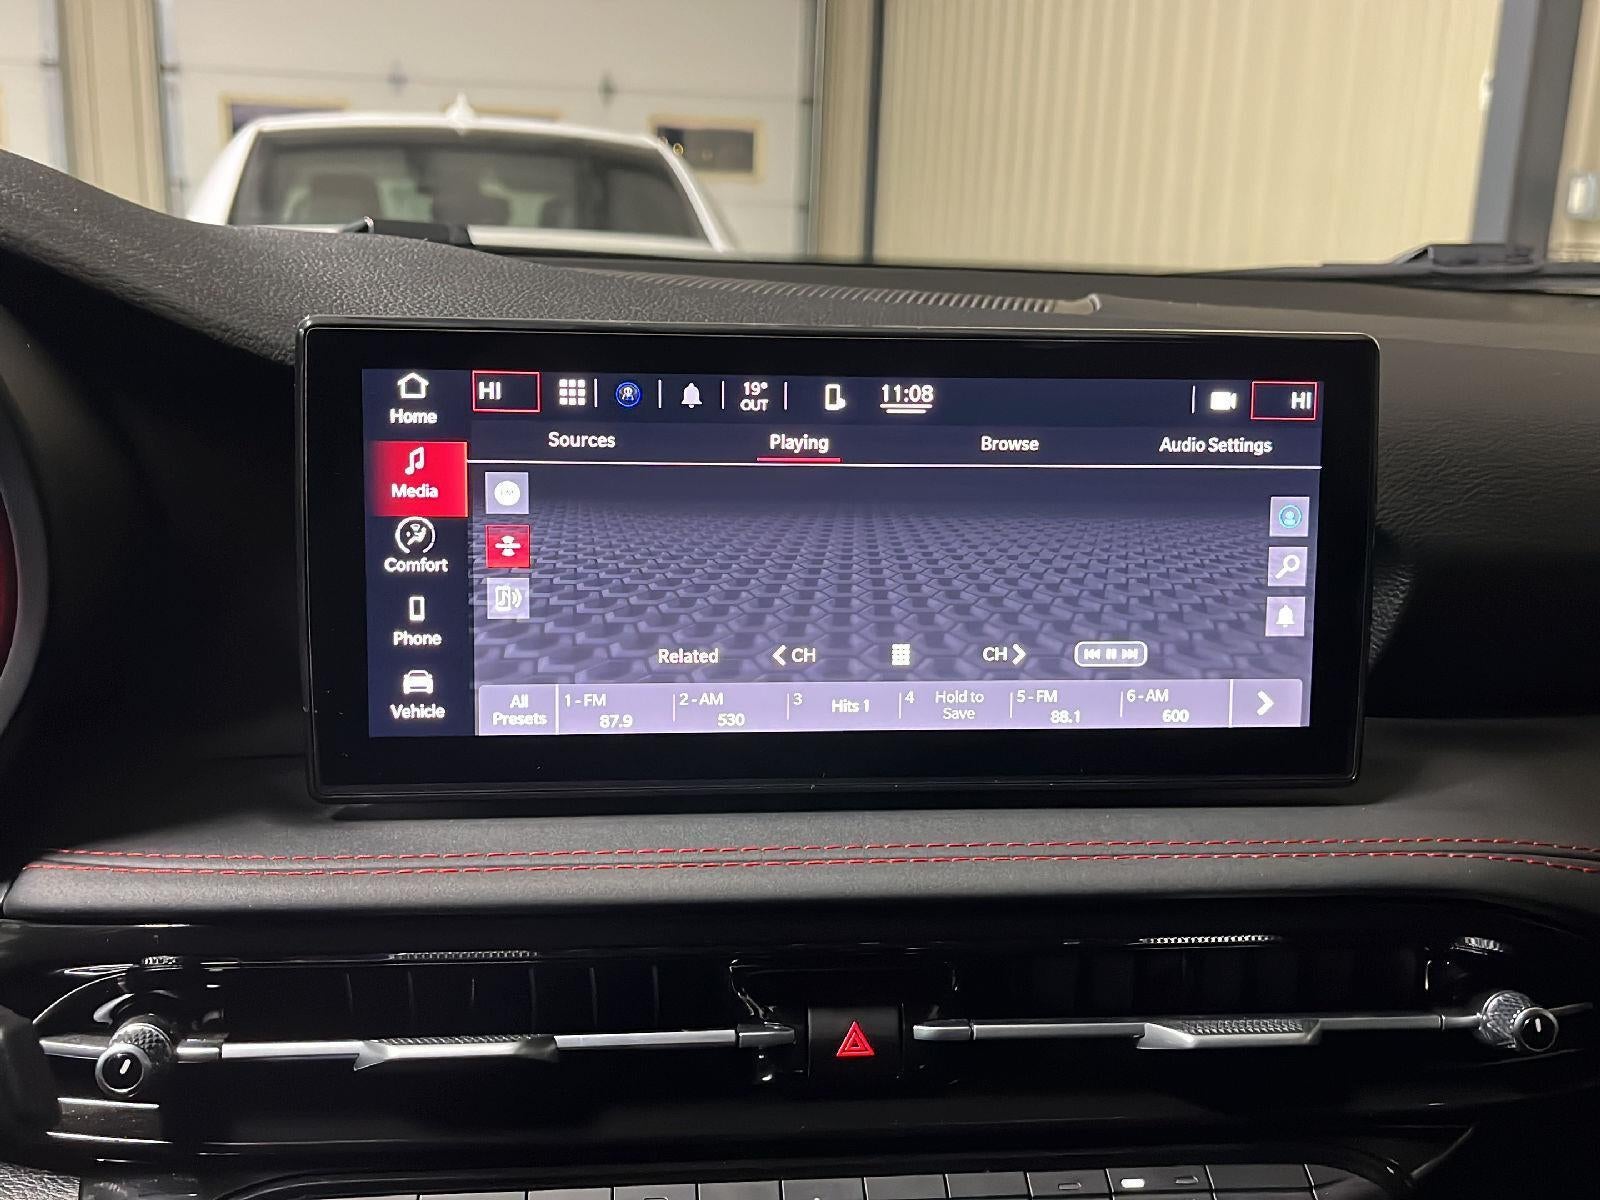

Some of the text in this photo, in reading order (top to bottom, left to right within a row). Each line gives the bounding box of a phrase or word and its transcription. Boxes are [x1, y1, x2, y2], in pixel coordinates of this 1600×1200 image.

[478, 381, 501, 400] HI
[743, 381, 768, 396] 19°
[881, 384, 934, 403] 11:08
[740, 399, 768, 412] OUT
[1290, 391, 1312, 410] HI
[390, 408, 437, 424] Home
[548, 431, 616, 449] Sources
[769, 433, 829, 454] Playing
[981, 435, 1039, 452] Browse
[1159, 437, 1273, 456] Audio Settings
[391, 483, 438, 498] Media
[384, 557, 448, 573] Comfort
[393, 631, 442, 646] Phone
[658, 648, 719, 664] Related
[791, 647, 816, 663] CH
[982, 646, 1008, 662] CH
[509, 694, 529, 708] All
[793, 693, 803, 706] 3
[904, 691, 915, 704] 4
[935, 690, 985, 704] Hold to
[390, 703, 445, 720] Vehicle
[831, 699, 870, 713] Hits 1
[942, 707, 976, 720] Save
[492, 712, 547, 727] Presets
[599, 714, 634, 729] 87.9
[717, 713, 746, 726] 530
[1050, 709, 1081, 724] 88.1
[1162, 709, 1190, 723] 600
